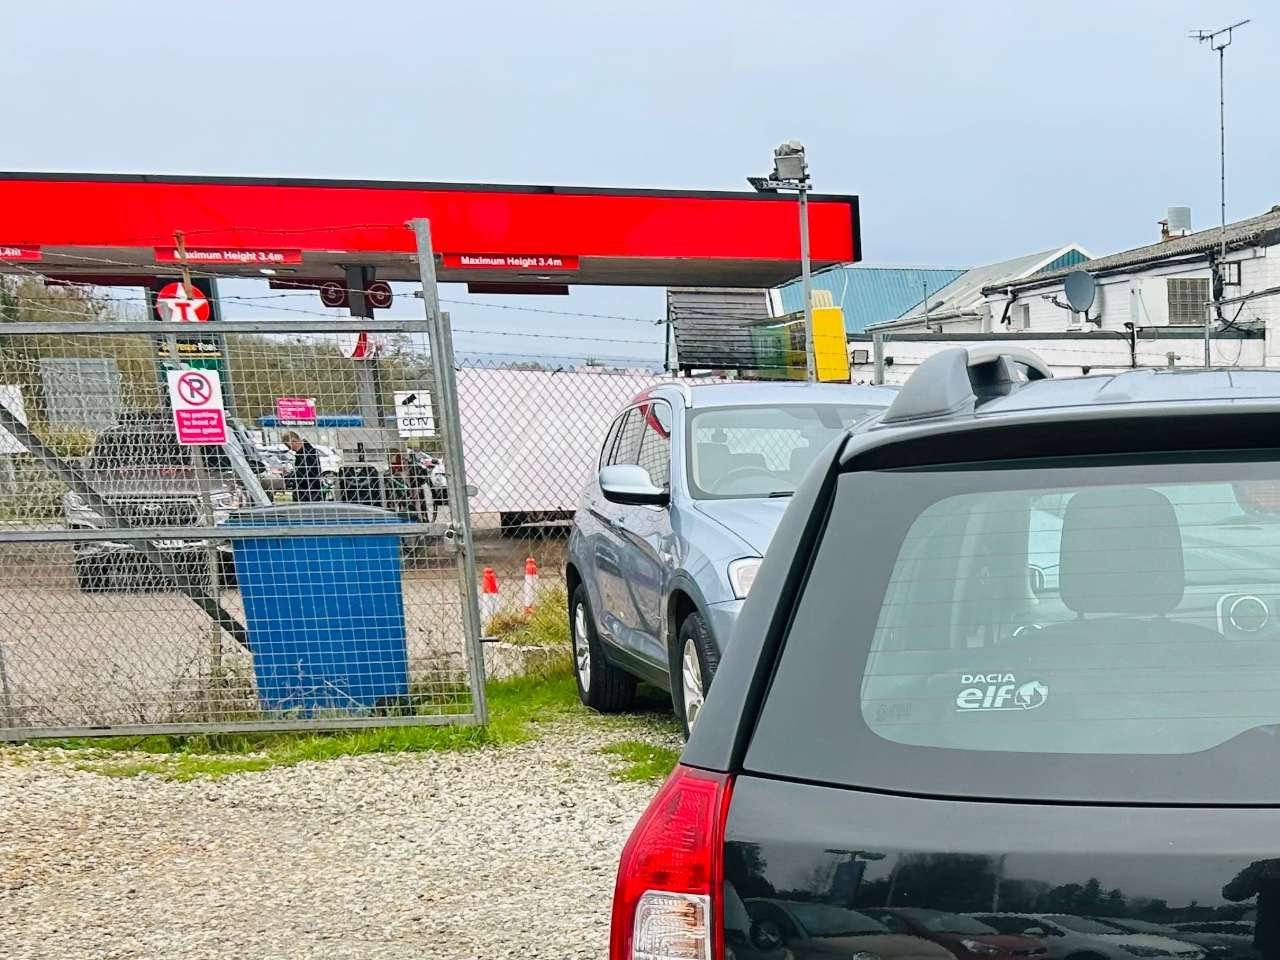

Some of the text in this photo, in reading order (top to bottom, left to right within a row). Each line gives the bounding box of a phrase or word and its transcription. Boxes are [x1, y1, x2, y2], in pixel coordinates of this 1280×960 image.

[223, 251, 257, 262] Height
[259, 252, 284, 261] 3.4m
[461, 256, 563, 268] Maximum Height 3.4m
[402, 416, 429, 427] CCTV
[960, 673, 1017, 684] DACIA
[955, 684, 1016, 709] elf
